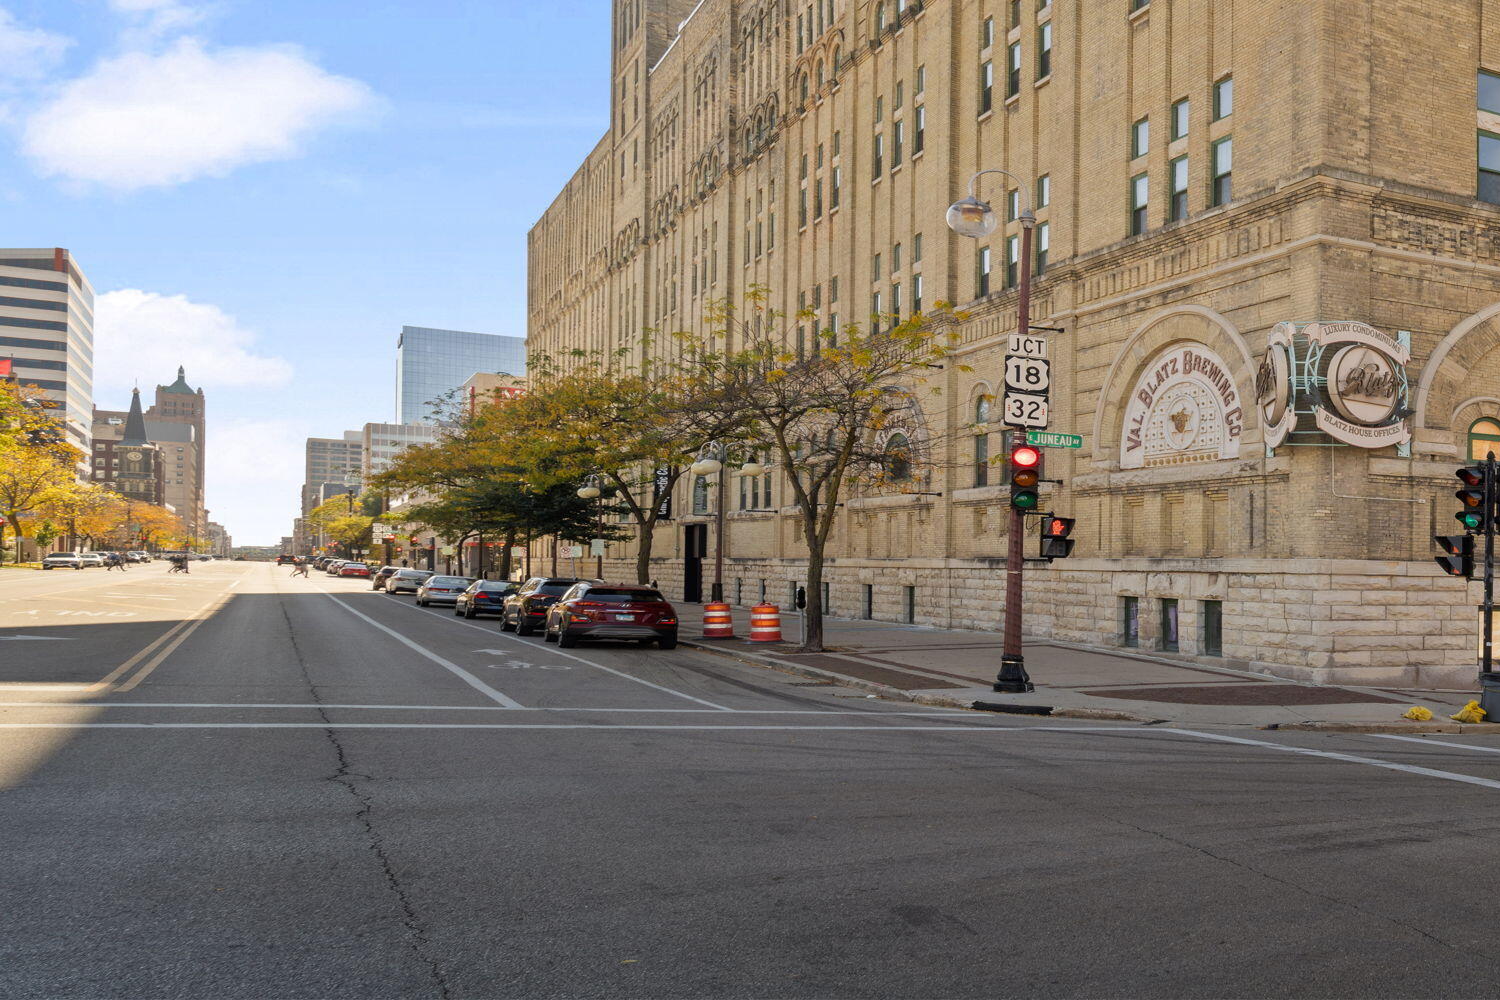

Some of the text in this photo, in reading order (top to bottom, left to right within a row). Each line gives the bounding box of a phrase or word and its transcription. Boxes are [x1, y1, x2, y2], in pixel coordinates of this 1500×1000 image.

[1011, 337, 1045, 355] JCT
[1324, 323, 1402, 354] LUXURY CONDOMINIUMS
[1014, 364, 1041, 385] 18
[1138, 357, 1179, 410] BLATZ
[1182, 350, 1236, 408] BREWING
[1341, 362, 1398, 399] Blatz
[1011, 399, 1040, 421] 32
[1323, 413, 1401, 438] BLATZ HOUSE OFFICES
[1034, 433, 1072, 446] JUNEAU
